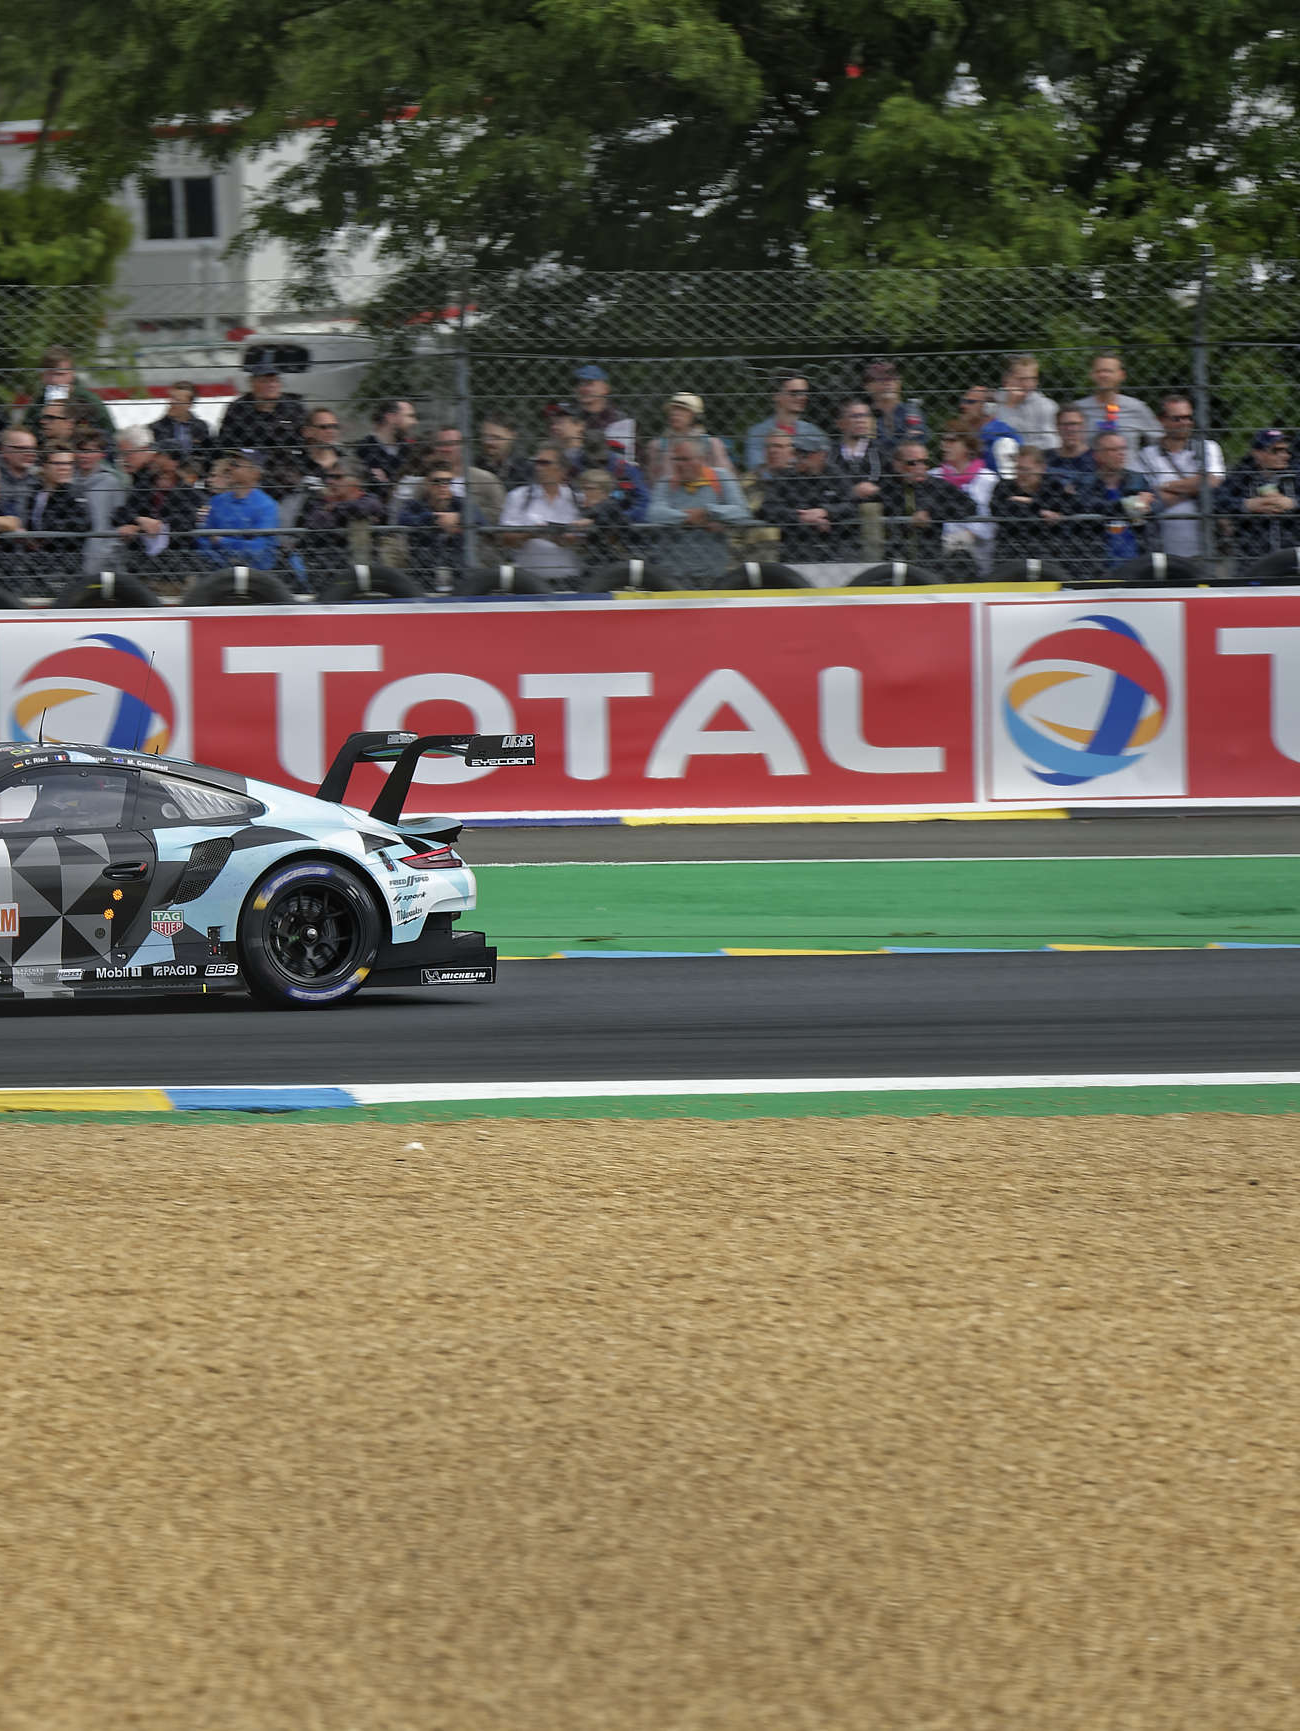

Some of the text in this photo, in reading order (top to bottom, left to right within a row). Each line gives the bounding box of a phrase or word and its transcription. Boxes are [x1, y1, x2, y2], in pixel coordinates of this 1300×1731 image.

[223, 645, 946, 786] TOTAL
[154, 912, 181, 920] TAG
[153, 921, 182, 937] HEUER
[96, 967, 129, 978] Mobil
[164, 966, 197, 976] PAGID
[205, 964, 238, 976] BBS
[441, 972, 486, 980] MICHELIN
